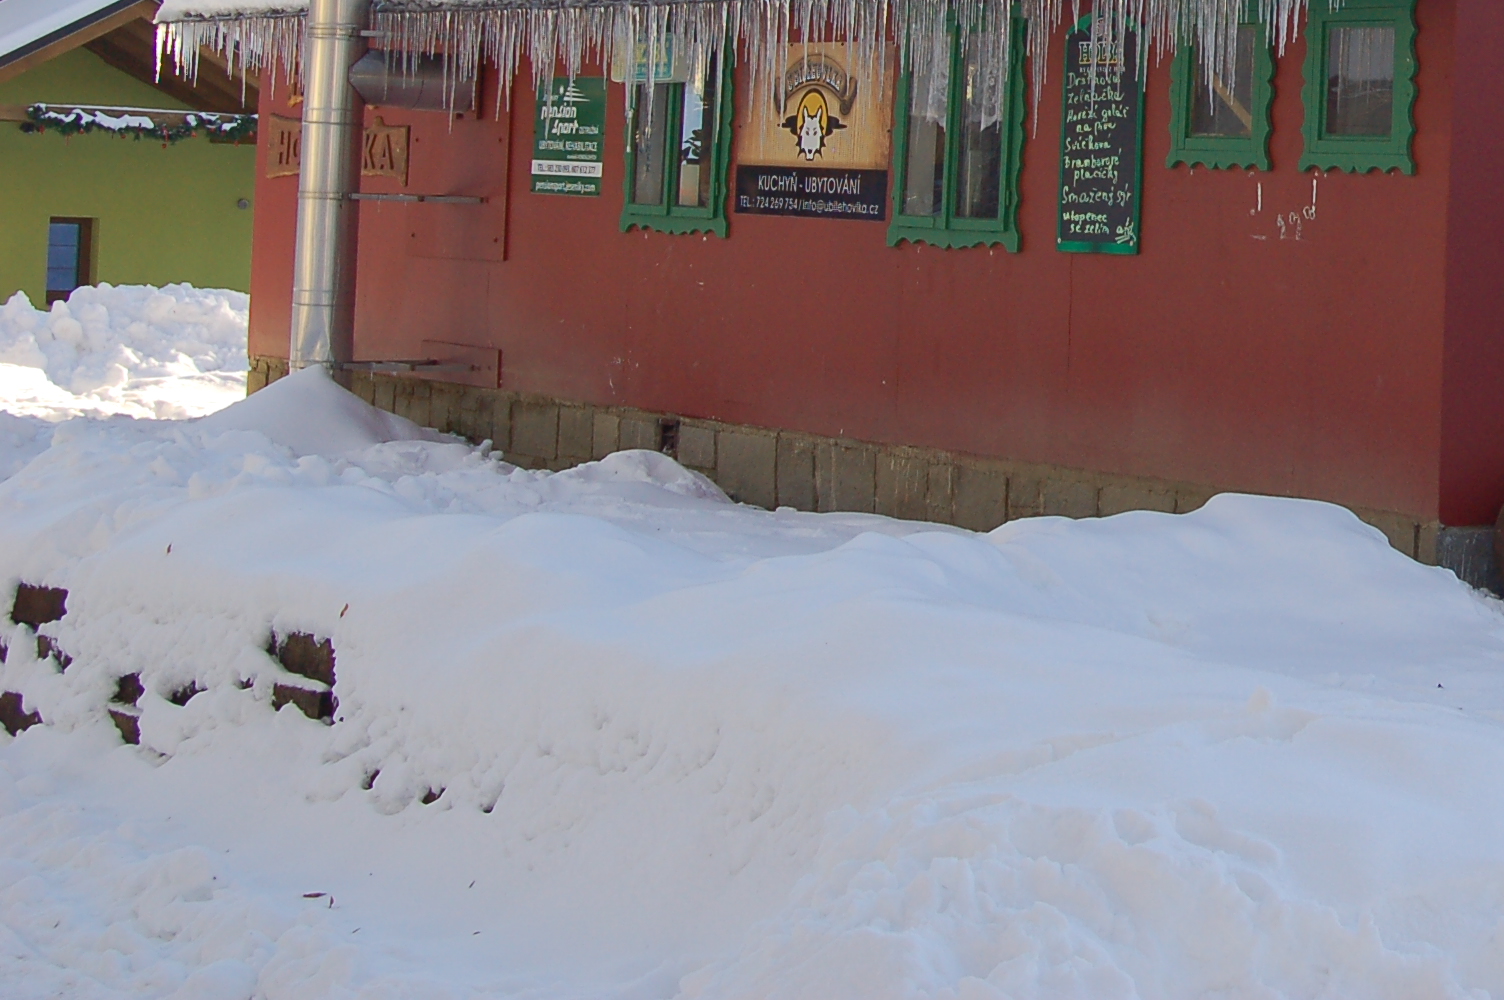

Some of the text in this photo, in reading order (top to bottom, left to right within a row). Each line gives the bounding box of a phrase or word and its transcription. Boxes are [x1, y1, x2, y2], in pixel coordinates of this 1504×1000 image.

[758, 171, 798, 192] KUCHYŇ
[804, 173, 862, 195] UBYTOVÁNÍ
[756, 196, 769, 209] 724
[784, 199, 797, 210] 754
